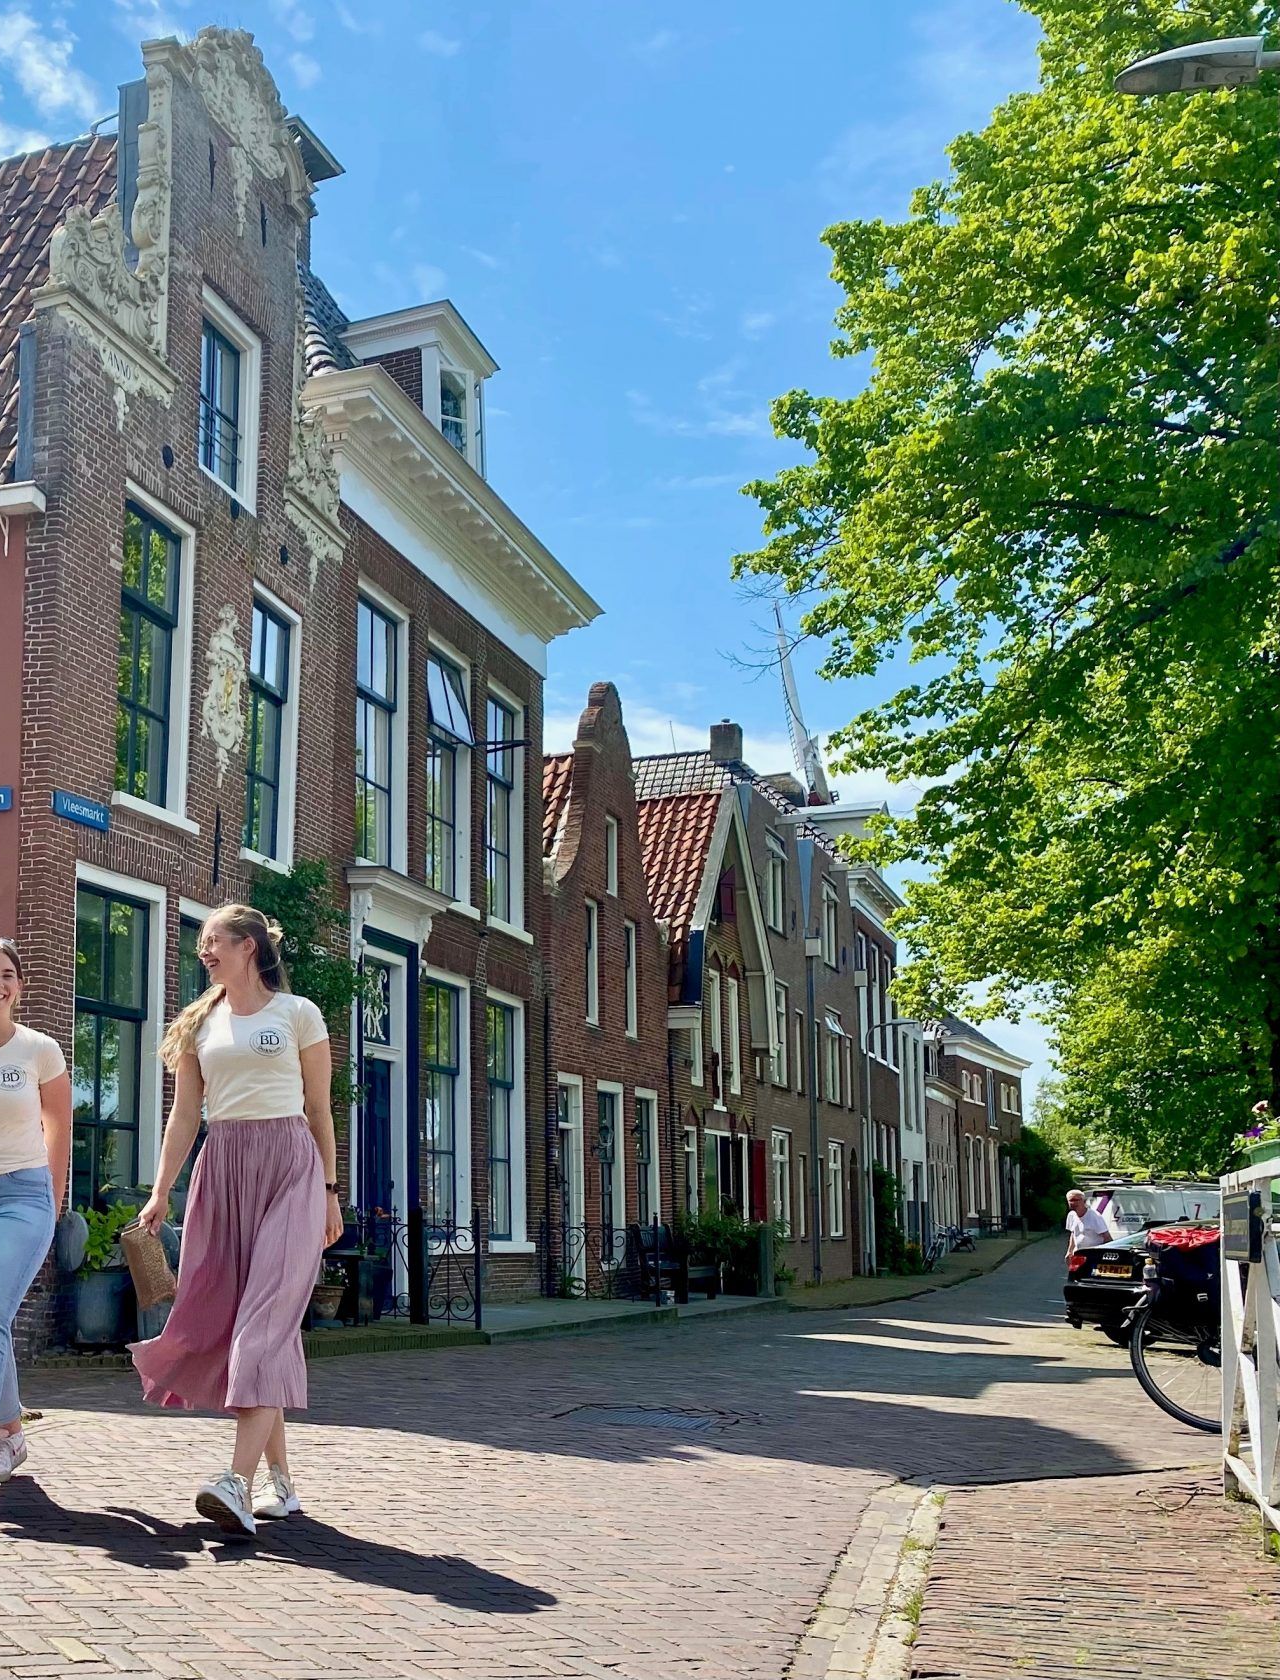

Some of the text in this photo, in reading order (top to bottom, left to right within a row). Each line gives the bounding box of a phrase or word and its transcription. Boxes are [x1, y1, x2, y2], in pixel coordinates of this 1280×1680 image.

[108, 350, 131, 380] ANNO
[62, 796, 105, 823] Vleesmarkt
[260, 1034, 280, 1046] BD
[2, 1072, 20, 1083] BD
